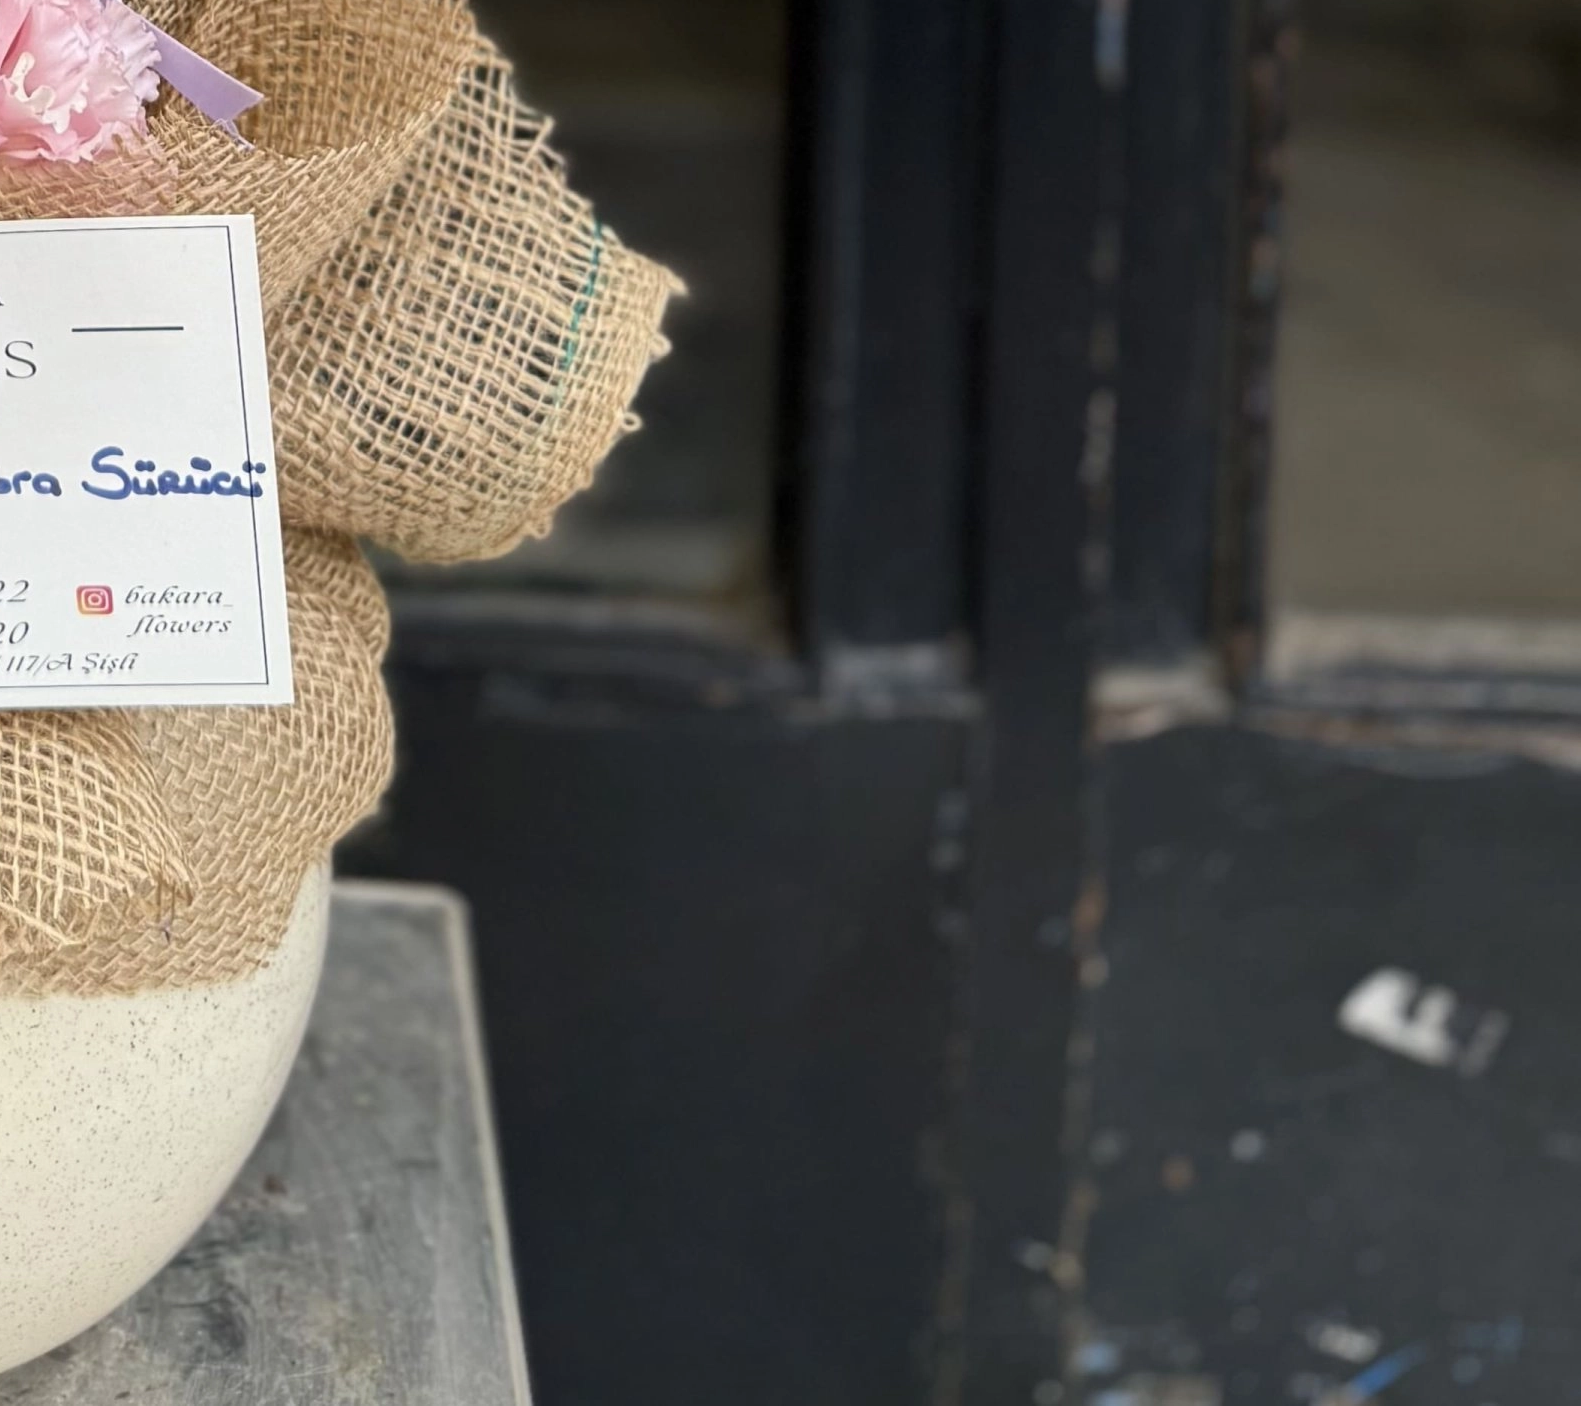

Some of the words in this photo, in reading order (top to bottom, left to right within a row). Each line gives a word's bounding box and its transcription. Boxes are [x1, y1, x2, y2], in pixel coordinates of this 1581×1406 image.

[126, 614, 232, 638] flowers
[6, 653, 73, 676] 117/A
[82, 652, 139, 675] Şişli
